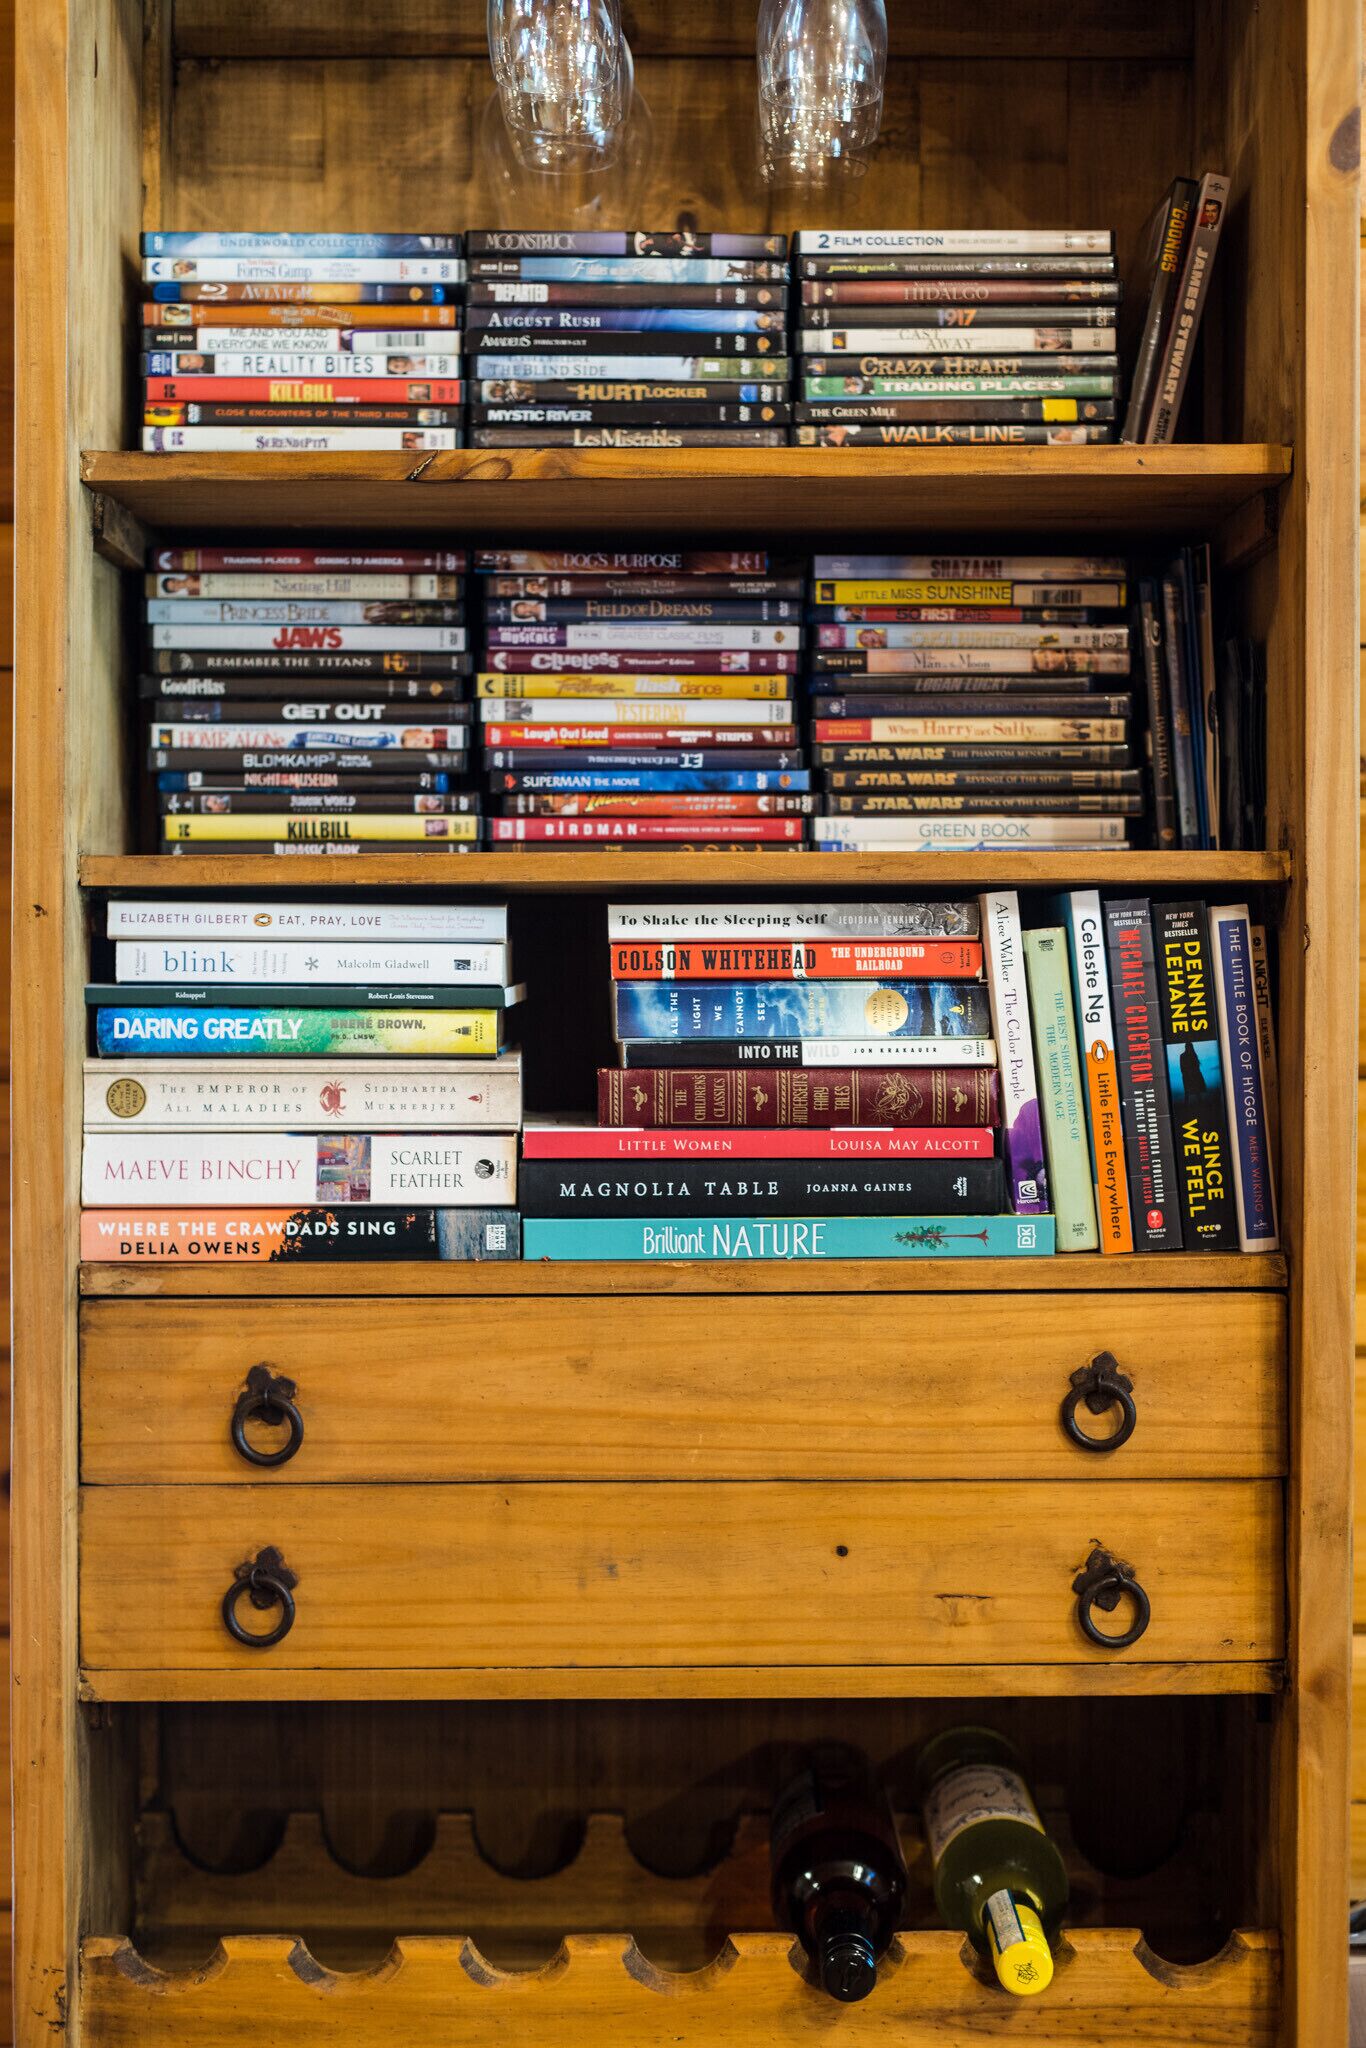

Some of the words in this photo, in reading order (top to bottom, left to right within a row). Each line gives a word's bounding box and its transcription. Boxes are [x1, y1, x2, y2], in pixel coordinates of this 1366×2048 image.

[219, 238, 304, 247] UNDERWORLD
[308, 238, 385, 248] COLLECTION
[818, 234, 830, 249] 2
[833, 236, 862, 246] FILM
[866, 236, 944, 246] COLLECTION
[1160, 207, 1187, 273] GOONIES
[1184, 246, 1208, 311] JAMES
[904, 287, 989, 300] HIDALGO
[488, 312, 553, 328] AUGUST
[559, 312, 601, 327] RUSH
[938, 309, 977, 326] 1917
[243, 356, 315, 373] REALITY
[325, 356, 374, 373] BITES
[860, 356, 936, 375] CRAZY
[942, 355, 1022, 374] HEART
[1162, 313, 1193, 404] STEWART
[880, 382, 976, 392] TRADING
[980, 381, 1066, 391] PLACES
[487, 409, 544, 422] MYSTIC
[546, 409, 592, 422] RIVER
[880, 426, 954, 443] WALK
[969, 426, 1025, 443] LINE
[854, 589, 888, 600] LITTLE
[890, 588, 922, 599] MISS
[927, 585, 1012, 600] SUNSHINE
[272, 627, 343, 649] JAWS
[206, 657, 280, 667] REMEMBER
[285, 657, 311, 667] THE
[317, 657, 372, 667] TITANS
[282, 703, 331, 720] GET
[334, 703, 386, 720] OUT
[524, 727, 558, 742] Laugh
[559, 728, 581, 739] Out
[582, 727, 609, 740] Loud
[844, 748, 894, 761] STAR
[895, 748, 946, 761] WARS
[522, 775, 591, 787] SUPERMAN
[593, 777, 609, 786] THE
[612, 777, 641, 787] MOVIE
[855, 772, 906, 786] STAR
[906, 772, 957, 785] WARS
[862, 796, 913, 810] STAR
[913, 796, 965, 809] WARS
[919, 823, 976, 838] GREEN
[981, 823, 1031, 838] BOOK
[120, 913, 189, 924] ELIZABETH
[194, 914, 248, 925] GILBERT
[279, 915, 305, 926] EAT,
[311, 916, 347, 927] PRAY,
[351, 916, 382, 926] LOVE
[618, 915, 638, 926] To
[642, 914, 689, 926] Shake
[695, 914, 718, 926] the
[723, 914, 792, 928] Sleeping
[796, 913, 828, 925] Self
[995, 901, 1010, 938] Alice
[1165, 912, 1178, 921] NEW
[1179, 912, 1195, 920] YORK
[1171, 920, 1189, 929] TIMES
[1164, 928, 1199, 938] BESTSELLER
[1228, 926, 1242, 952] THE
[163, 950, 235, 973] blink
[618, 950, 691, 971] COLSON
[701, 948, 817, 971] WHITEHEAD
[831, 947, 850, 958] THE
[854, 947, 925, 958] UNDERGROUND
[999, 936, 1014, 984] Walker
[1080, 918, 1101, 988] Celeste
[337, 958, 381, 969] Malcolm
[384, 958, 430, 969] Gladwell
[856, 959, 903, 971] RAILROAD
[1118, 929, 1146, 999] MICHAEL
[1164, 943, 1190, 1034] LEHANE
[1183, 941, 1209, 1032] DENNIS
[1231, 958, 1246, 999] LITTLE
[1254, 959, 1269, 1008] NIGHT
[175, 991, 206, 1000] Kidnapped
[368, 992, 388, 1001] Robert
[389, 992, 405, 1000] Louis
[406, 992, 434, 1001] Stevenson
[670, 992, 678, 1013] THE
[1003, 987, 1018, 1016] The
[1054, 990, 1064, 1013] THE
[693, 997, 701, 1029] LIGHT
[714, 1004, 723, 1021] WE
[736, 990, 744, 1034] CANNOT
[757, 1002, 766, 1021] SEE
[1084, 993, 1104, 1023] Ng
[113, 1017, 199, 1040] DARING
[203, 1017, 304, 1040] GREATLY
[331, 1016, 373, 1029] BRENÉ
[377, 1019, 426, 1031] BROWN,
[670, 1015, 679, 1035] ALL
[1056, 1015, 1067, 1042] BEST
[1235, 1004, 1251, 1046] BOOK
[1006, 1019, 1021, 1056] Color
[1046, 1024, 1057, 1046] THE
[1124, 1004, 1154, 1084] CRICHTON
[738, 1045, 771, 1059] INTO
[774, 1045, 799, 1058] THE
[806, 1044, 840, 1058] WILD
[1059, 1044, 1072, 1079] SHORT
[1240, 1050, 1252, 1071] OF
[1010, 1058, 1026, 1100] Purple
[1048, 1052, 1061, 1096] MODERN
[364, 1083, 457, 1093] SIDDHARTHA
[674, 1088, 687, 1108] THE
[694, 1074, 706, 1121] CHILDREN'S
[713, 1077, 726, 1117] CLASSICS
[1096, 1072, 1113, 1107] Little
[1145, 1088, 1155, 1103] THE
[364, 1101, 456, 1111] MUKHERJEE
[1054, 1099, 1066, 1121] AGE
[1063, 1081, 1077, 1125] STORIES
[1242, 1076, 1257, 1128] HYGGE
[1070, 1127, 1081, 1142] OF
[1101, 1112, 1115, 1146] Fires
[1147, 1107, 1161, 1155] ANDROMEDA
[1181, 1118, 1201, 1157] WE
[619, 1139, 667, 1151] LITTLE
[673, 1139, 733, 1151] WOMEN
[830, 1139, 881, 1151] LOUISA
[888, 1139, 918, 1151] MAY
[924, 1139, 980, 1151] ALCOTT
[1247, 1135, 1261, 1163] MEIK
[391, 1150, 463, 1166] SCARLET
[1202, 1131, 1225, 1201] SINCE
[104, 1159, 189, 1180] MAEVE
[201, 1159, 302, 1180] BINCHY
[390, 1173, 465, 1188] FEATHER
[559, 1182, 691, 1197] MAGNOLIA
[704, 1182, 779, 1196] TABLE
[806, 1183, 858, 1193] JOANNA
[864, 1183, 912, 1192] GAINES
[1151, 1158, 1165, 1204] EVOLUTION
[1251, 1167, 1265, 1214] WIKING
[1104, 1150, 1124, 1240] Everywhere
[1185, 1164, 1207, 1218] FELL
[98, 1221, 170, 1236] WHERE
[177, 1221, 217, 1236] THE
[225, 1221, 340, 1236] CRAWDADS
[347, 1221, 397, 1236] SING
[1020, 1227, 1032, 1246] DK
[1196, 1223, 1222, 1233] ecco
[120, 1242, 179, 1255] DELIA
[188, 1241, 261, 1255] OWENS
[643, 1226, 706, 1255] Brilliant
[712, 1223, 827, 1257] NATURE
